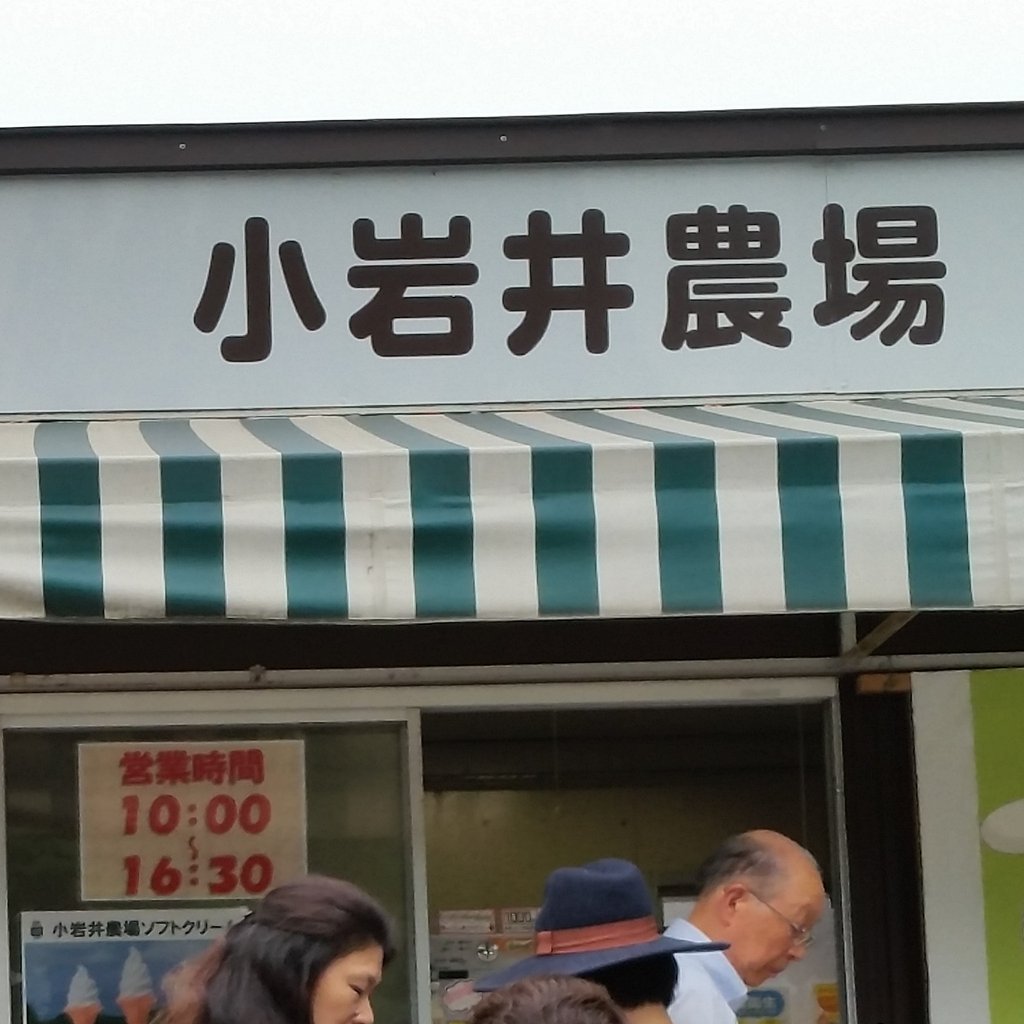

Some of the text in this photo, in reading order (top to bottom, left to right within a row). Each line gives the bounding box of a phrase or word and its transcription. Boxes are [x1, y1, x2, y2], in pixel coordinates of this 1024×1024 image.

[194, 203, 947, 363] 小岩井農場
[119, 749, 265, 786] 営業時間
[122, 793, 272, 836] 10:00
[123, 853, 274, 897] 16:30
[52, 918, 232, 939] 小岩井農場ソフトクリー
